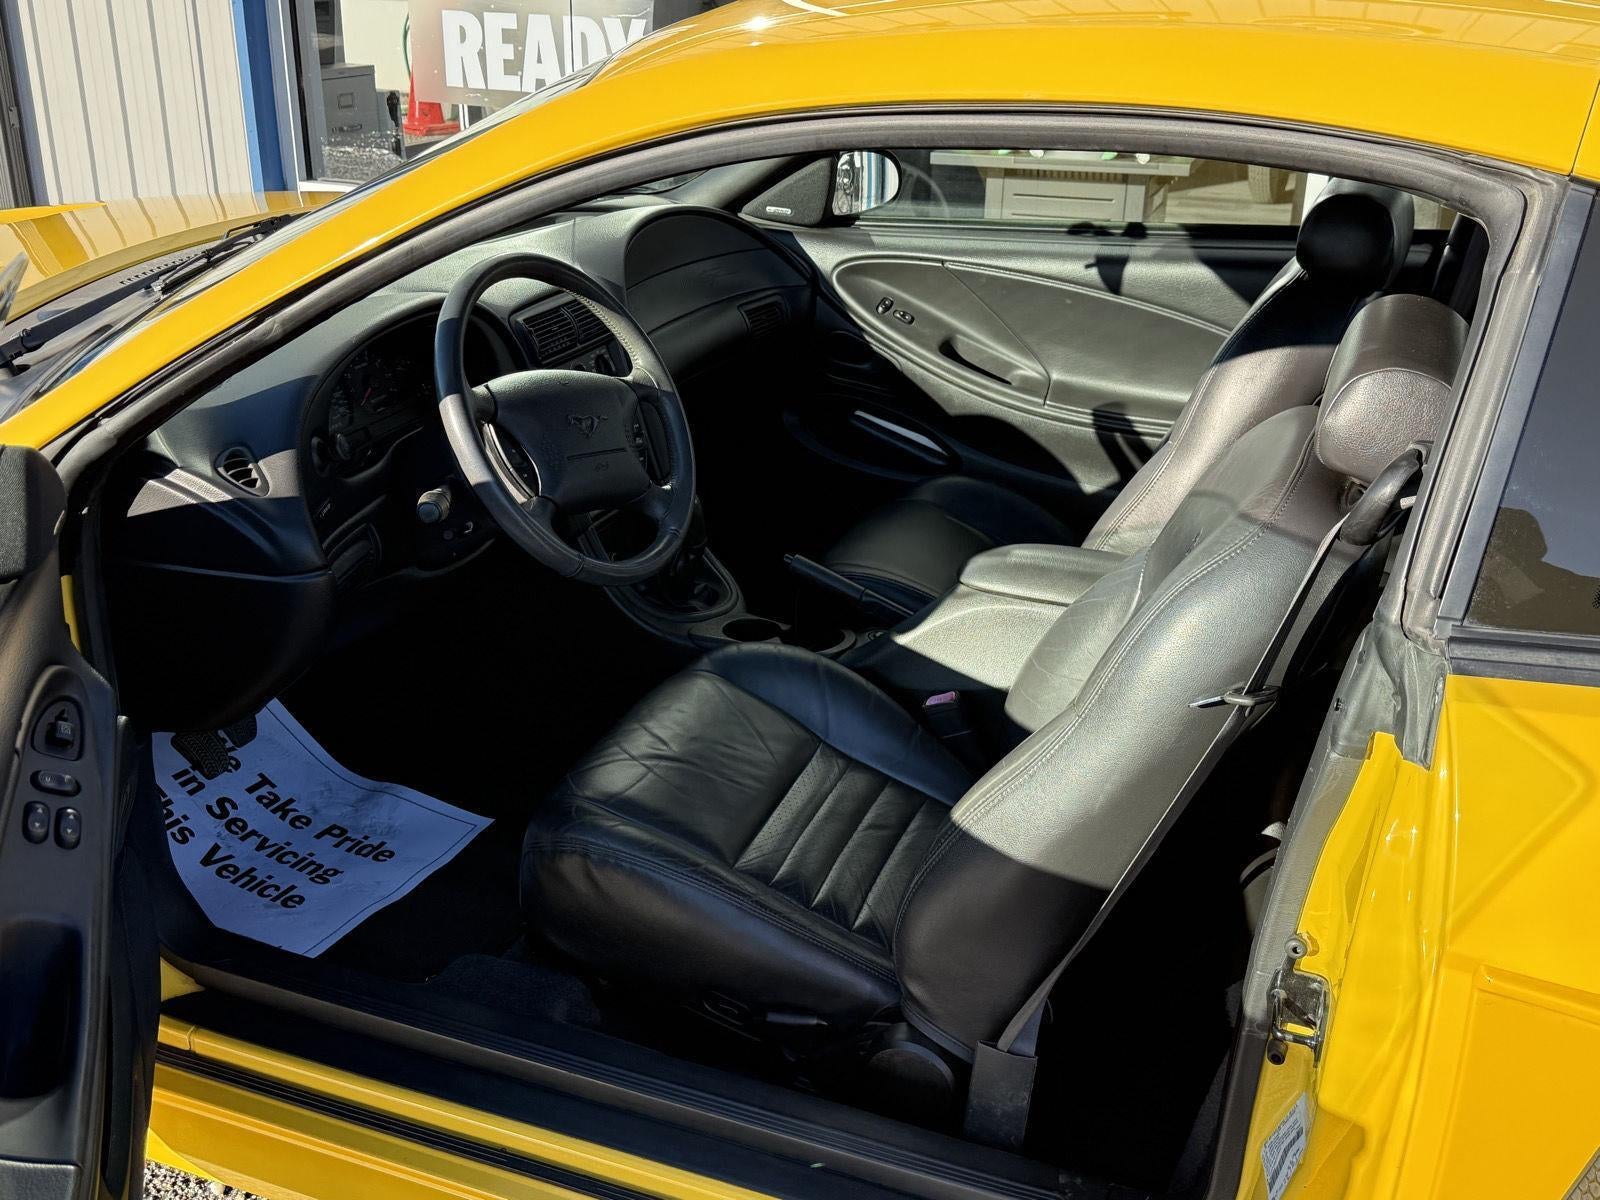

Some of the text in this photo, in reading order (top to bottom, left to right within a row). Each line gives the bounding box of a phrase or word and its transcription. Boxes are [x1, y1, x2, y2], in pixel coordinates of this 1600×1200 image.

[171, 768, 344, 885] in Servicing
[244, 773, 313, 830] Take
[313, 824, 396, 863] Pride
[200, 842, 306, 909] Vehicle
